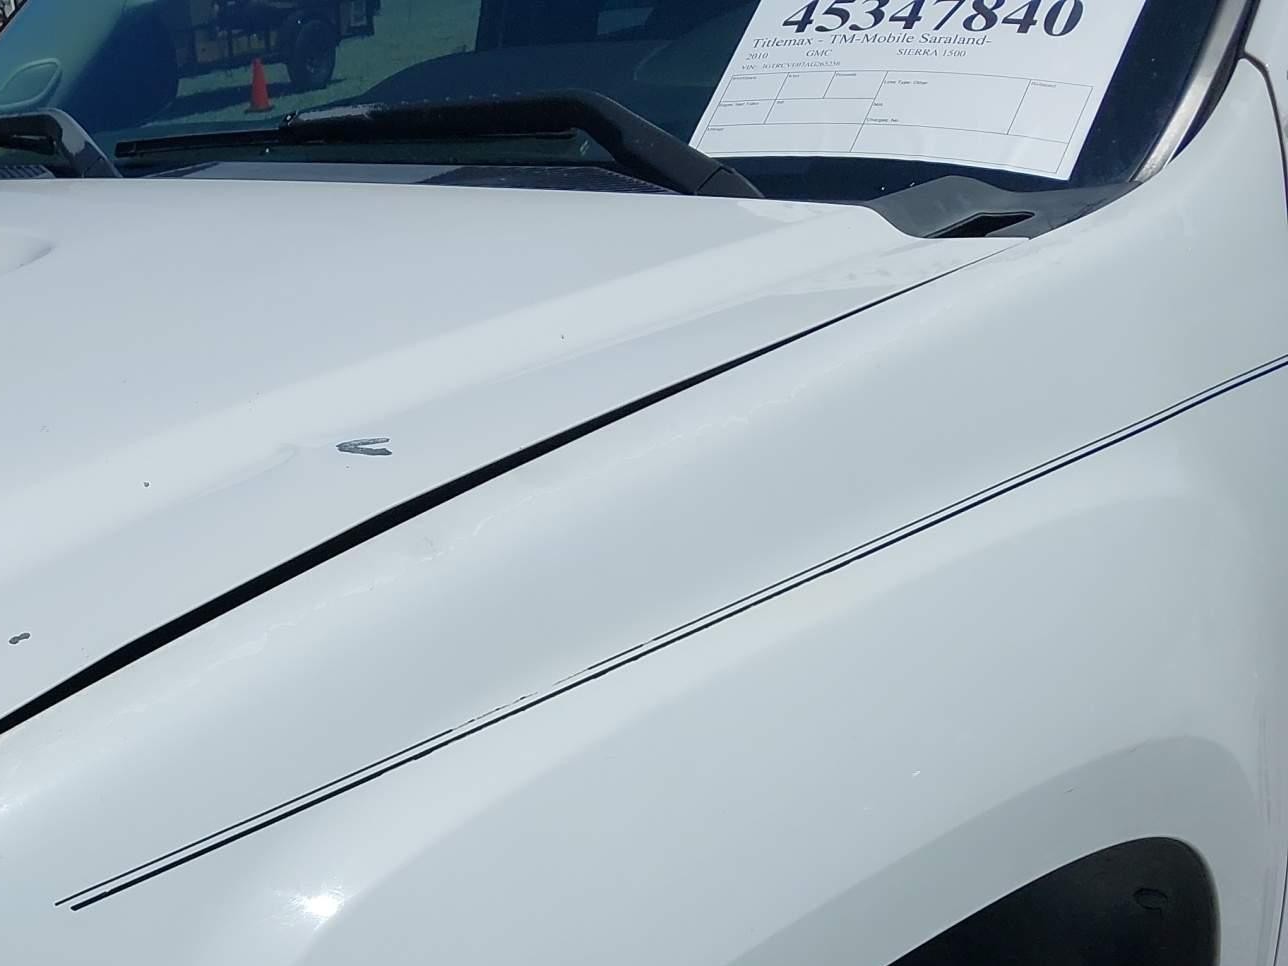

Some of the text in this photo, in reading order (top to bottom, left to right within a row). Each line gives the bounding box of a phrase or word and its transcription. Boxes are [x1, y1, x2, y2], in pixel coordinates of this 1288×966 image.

[782, 0, 1084, 37] 45347840
[752, 37, 814, 49] Titlemax
[830, 33, 915, 45] TM-Mobile
[746, 48, 967, 61] 2010 GMC SIERRA 1500
